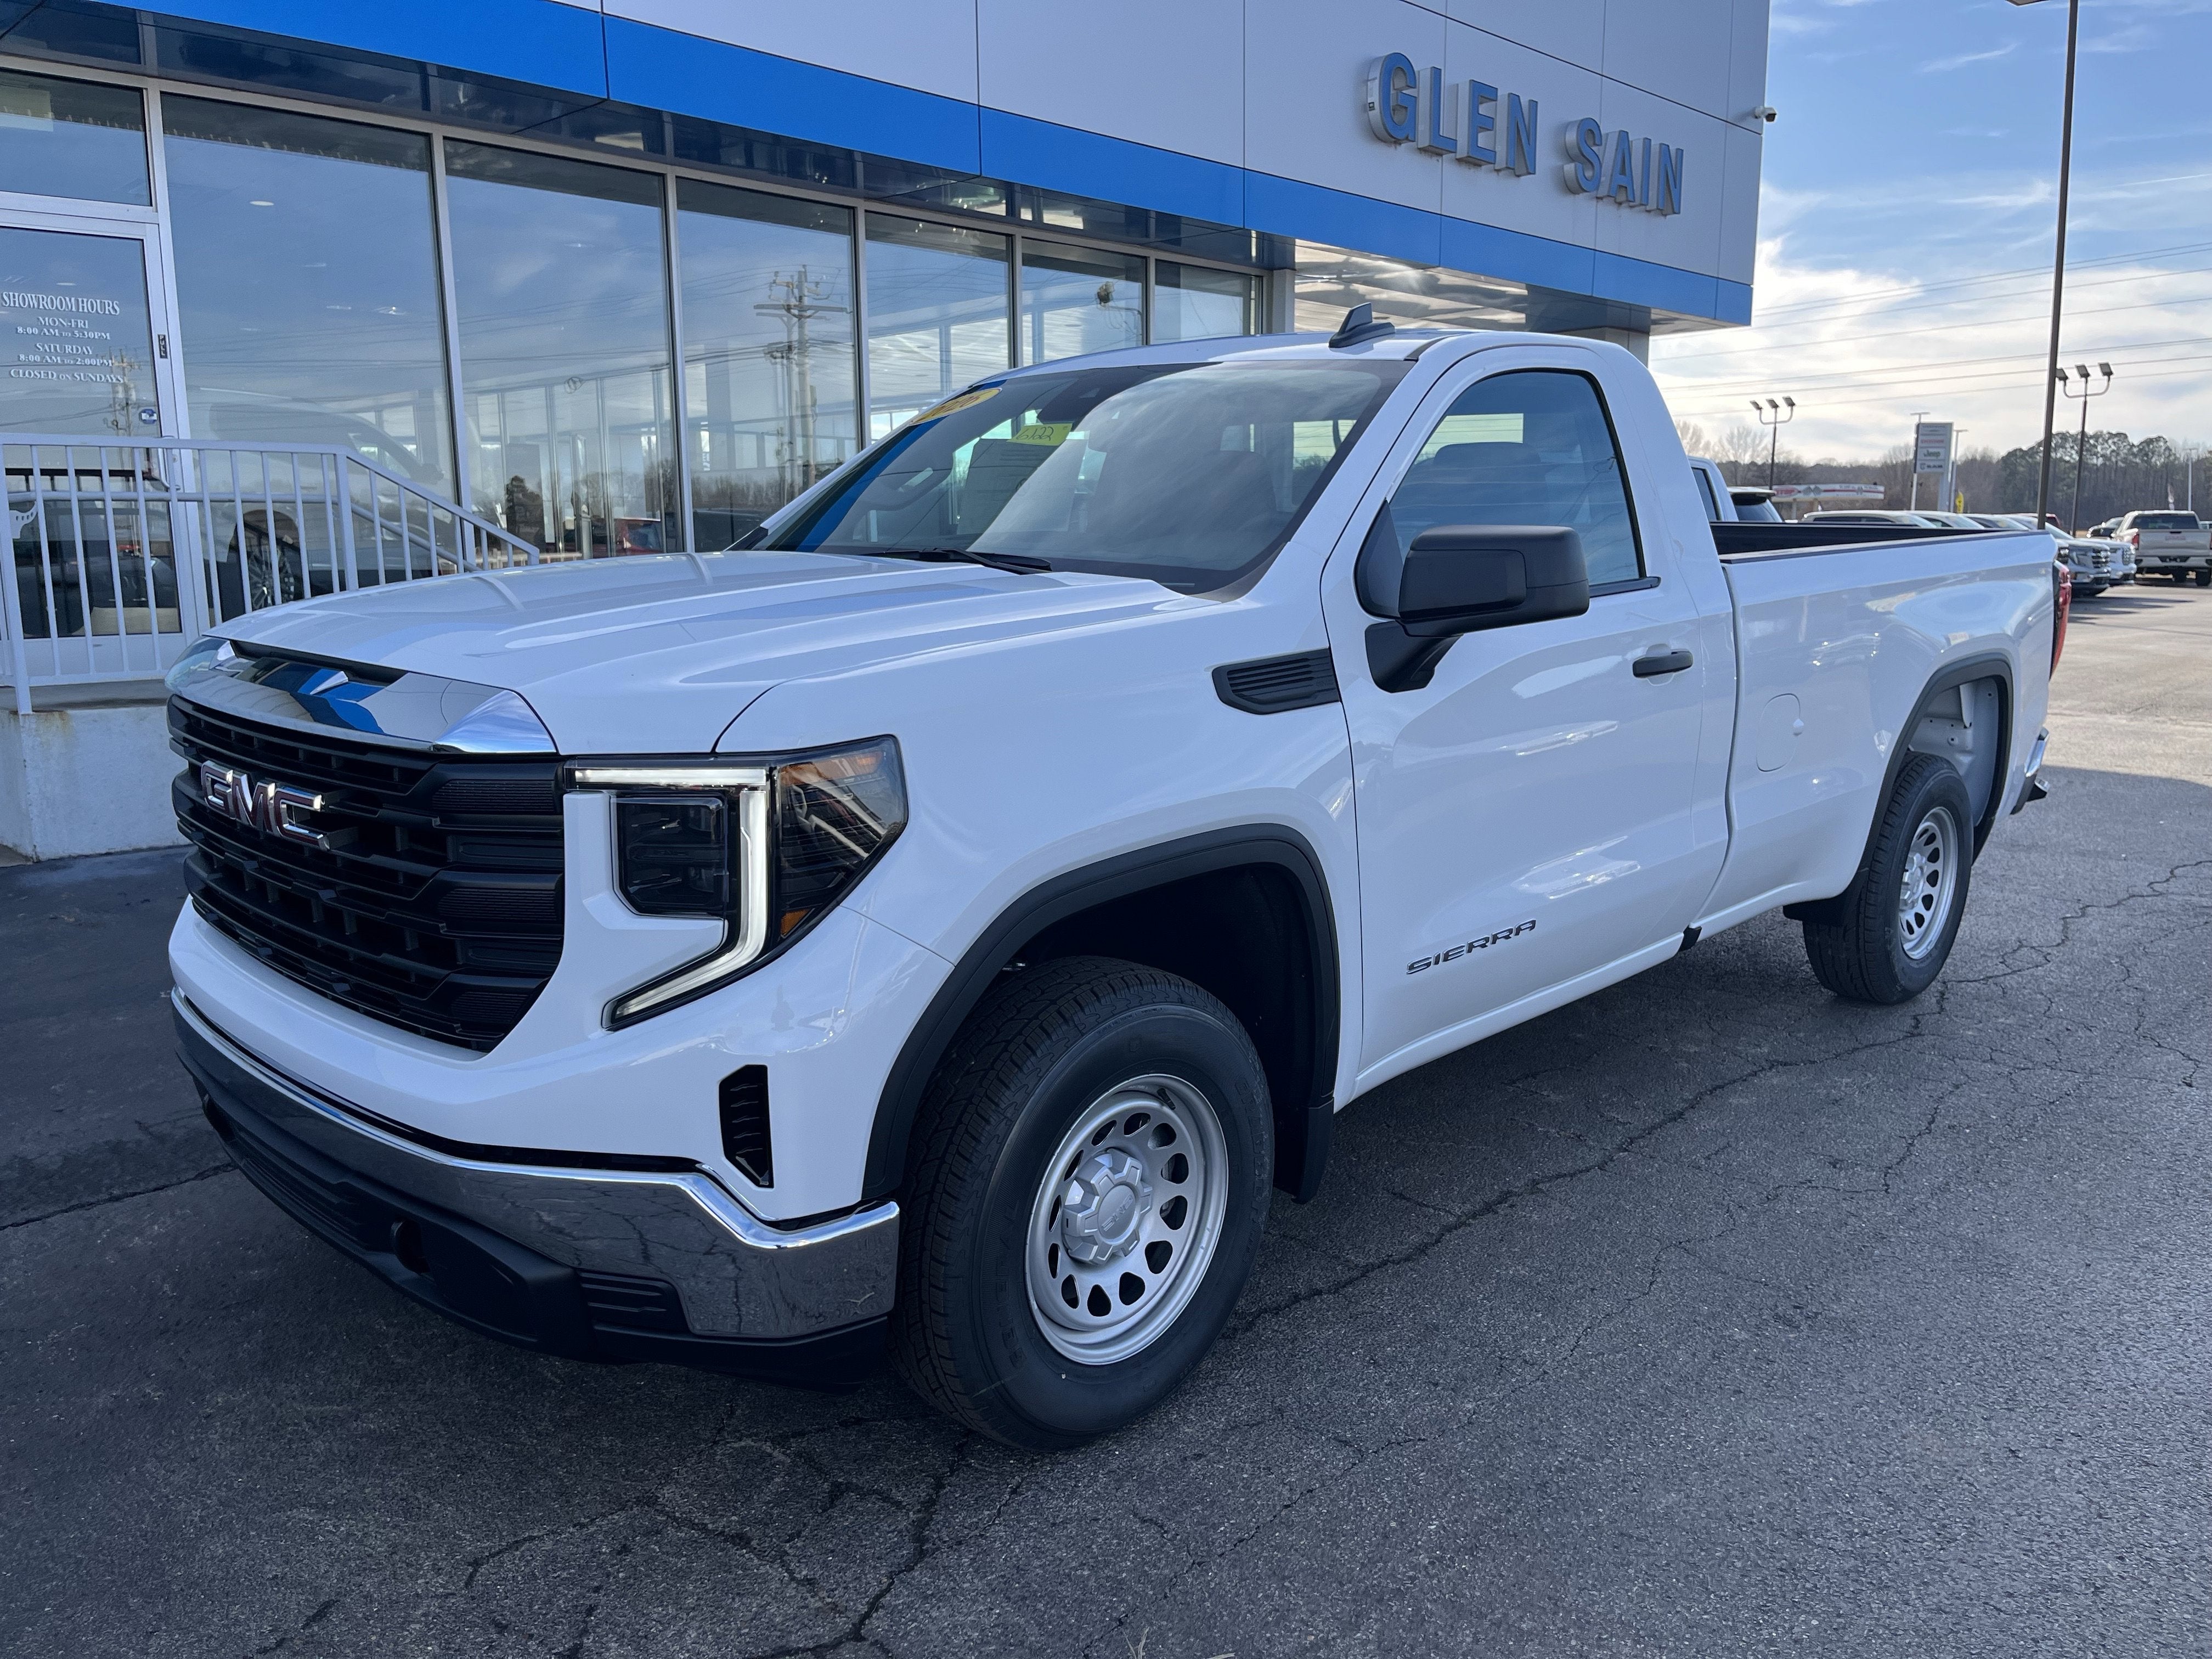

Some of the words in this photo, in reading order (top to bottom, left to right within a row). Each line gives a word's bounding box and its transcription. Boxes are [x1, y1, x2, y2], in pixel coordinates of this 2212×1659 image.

[1368, 52, 1538, 177] GLEN
[1564, 117, 1684, 215] SAIN
[3, 291, 75, 312] SHOWROOM
[78, 297, 120, 315] HOURS
[37, 317, 89, 329] MON-FRI
[17, 326, 38, 335] 8:00
[74, 330, 110, 340] 5:30PM
[36, 343, 94, 355] SATURDAY
[76, 358, 112, 367] 2:00PM
[10, 368, 57, 380] CLOSED
[74, 373, 124, 383] SUNDAYS
[1923, 450, 1941, 458] Jeep
[201, 760, 330, 850] GMC
[1406, 918, 1536, 975] SIERRA
[1101, 1194, 1134, 1232] GMC
